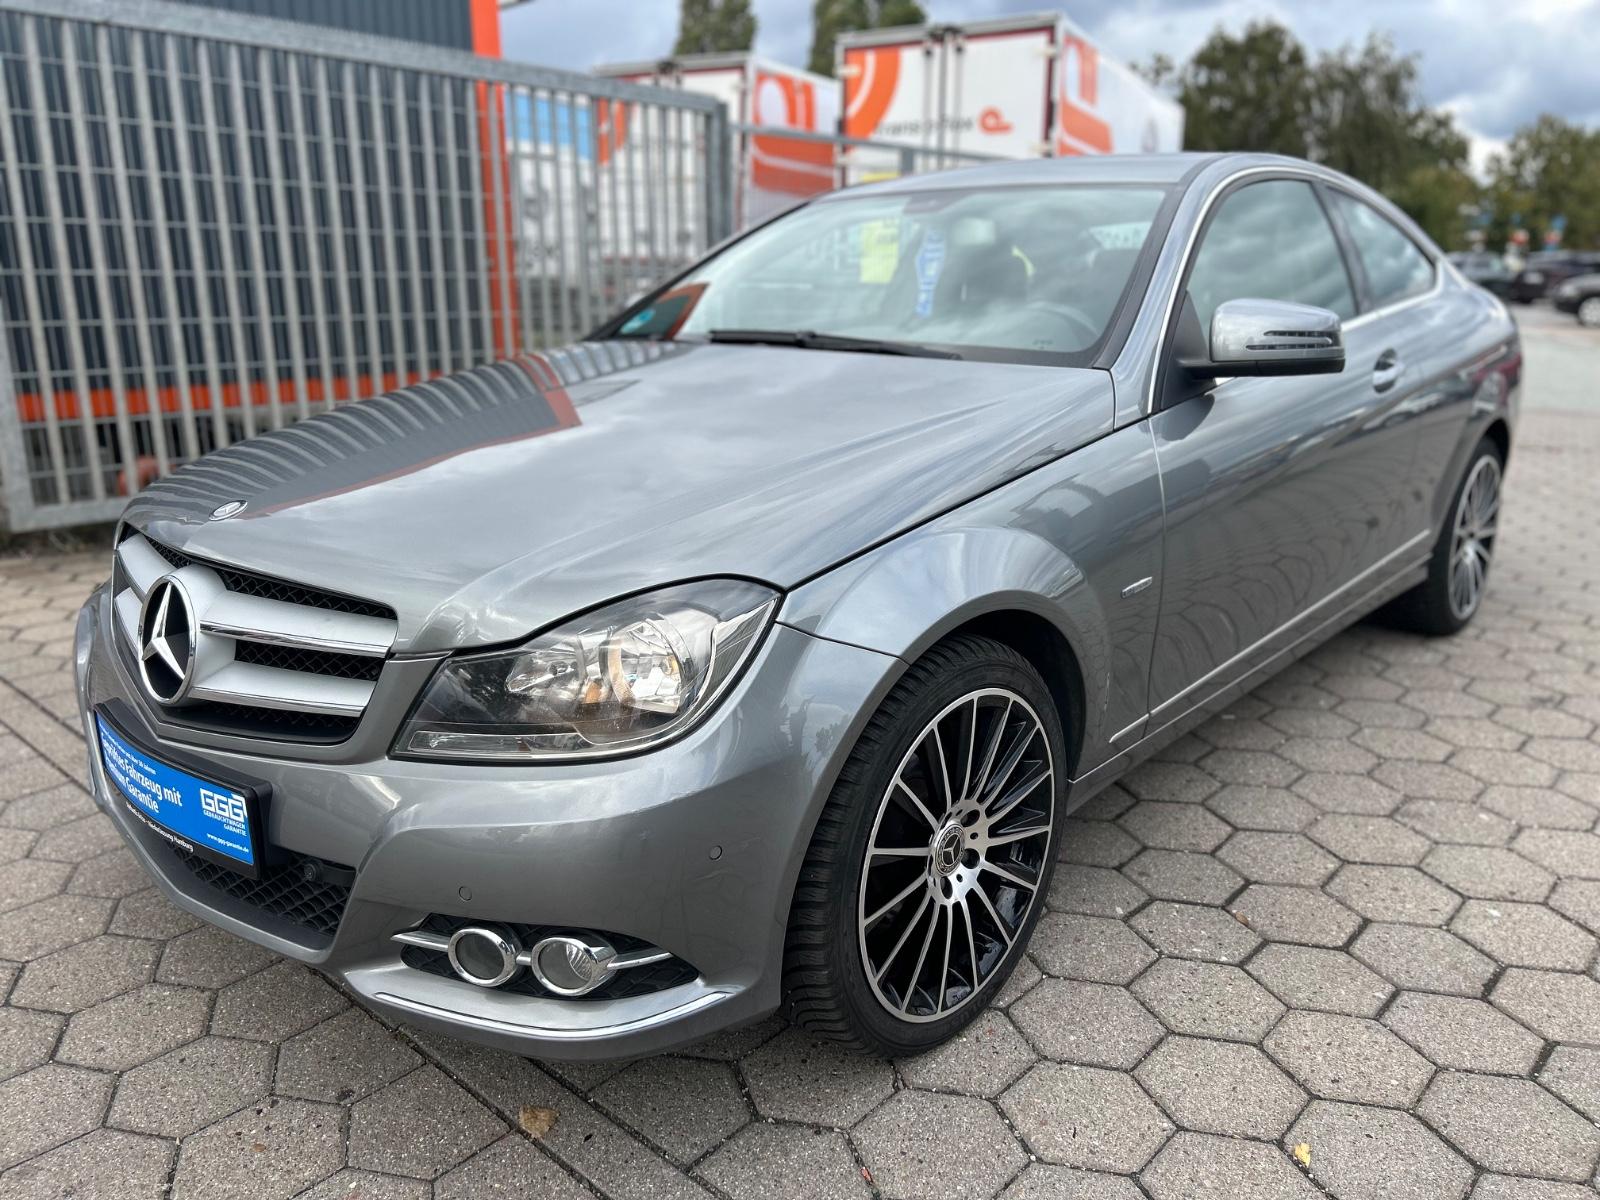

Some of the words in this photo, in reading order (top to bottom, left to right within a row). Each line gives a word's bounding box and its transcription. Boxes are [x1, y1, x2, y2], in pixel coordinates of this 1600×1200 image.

[125, 759, 162, 801] Fahrzeug
[163, 786, 183, 807] mit
[125, 775, 159, 814] Garantie
[199, 787, 245, 823] GGG
[203, 809, 246, 830] GEBRAUCHTWAGEN
[223, 823, 247, 837] GARANTIE
